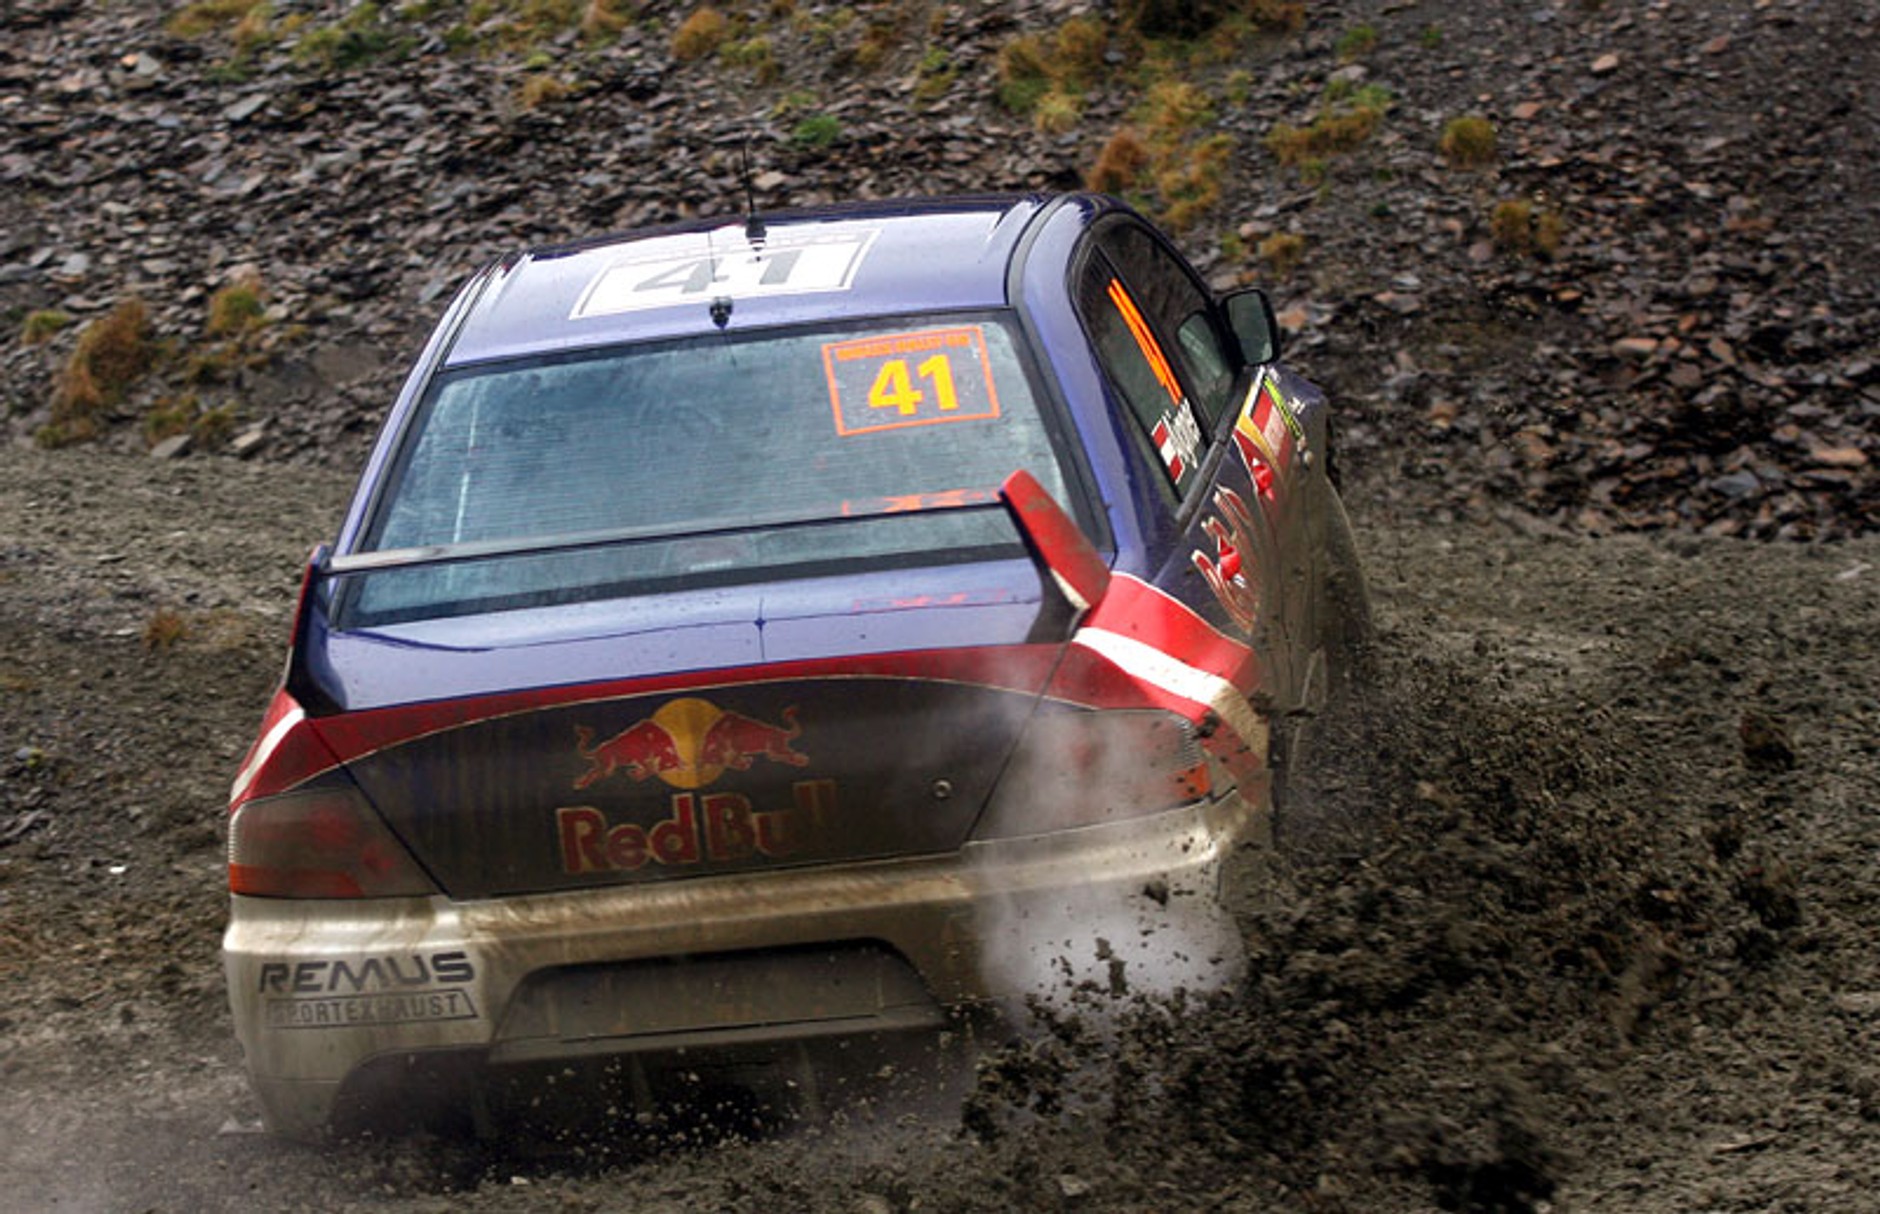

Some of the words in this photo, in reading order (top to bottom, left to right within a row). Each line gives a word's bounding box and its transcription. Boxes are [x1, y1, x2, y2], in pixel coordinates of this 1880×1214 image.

[633, 249, 804, 294] 41
[868, 354, 959, 415] 41
[556, 792, 698, 874] Red
[701, 778, 837, 860] Bull
[259, 951, 475, 992] REMUS
